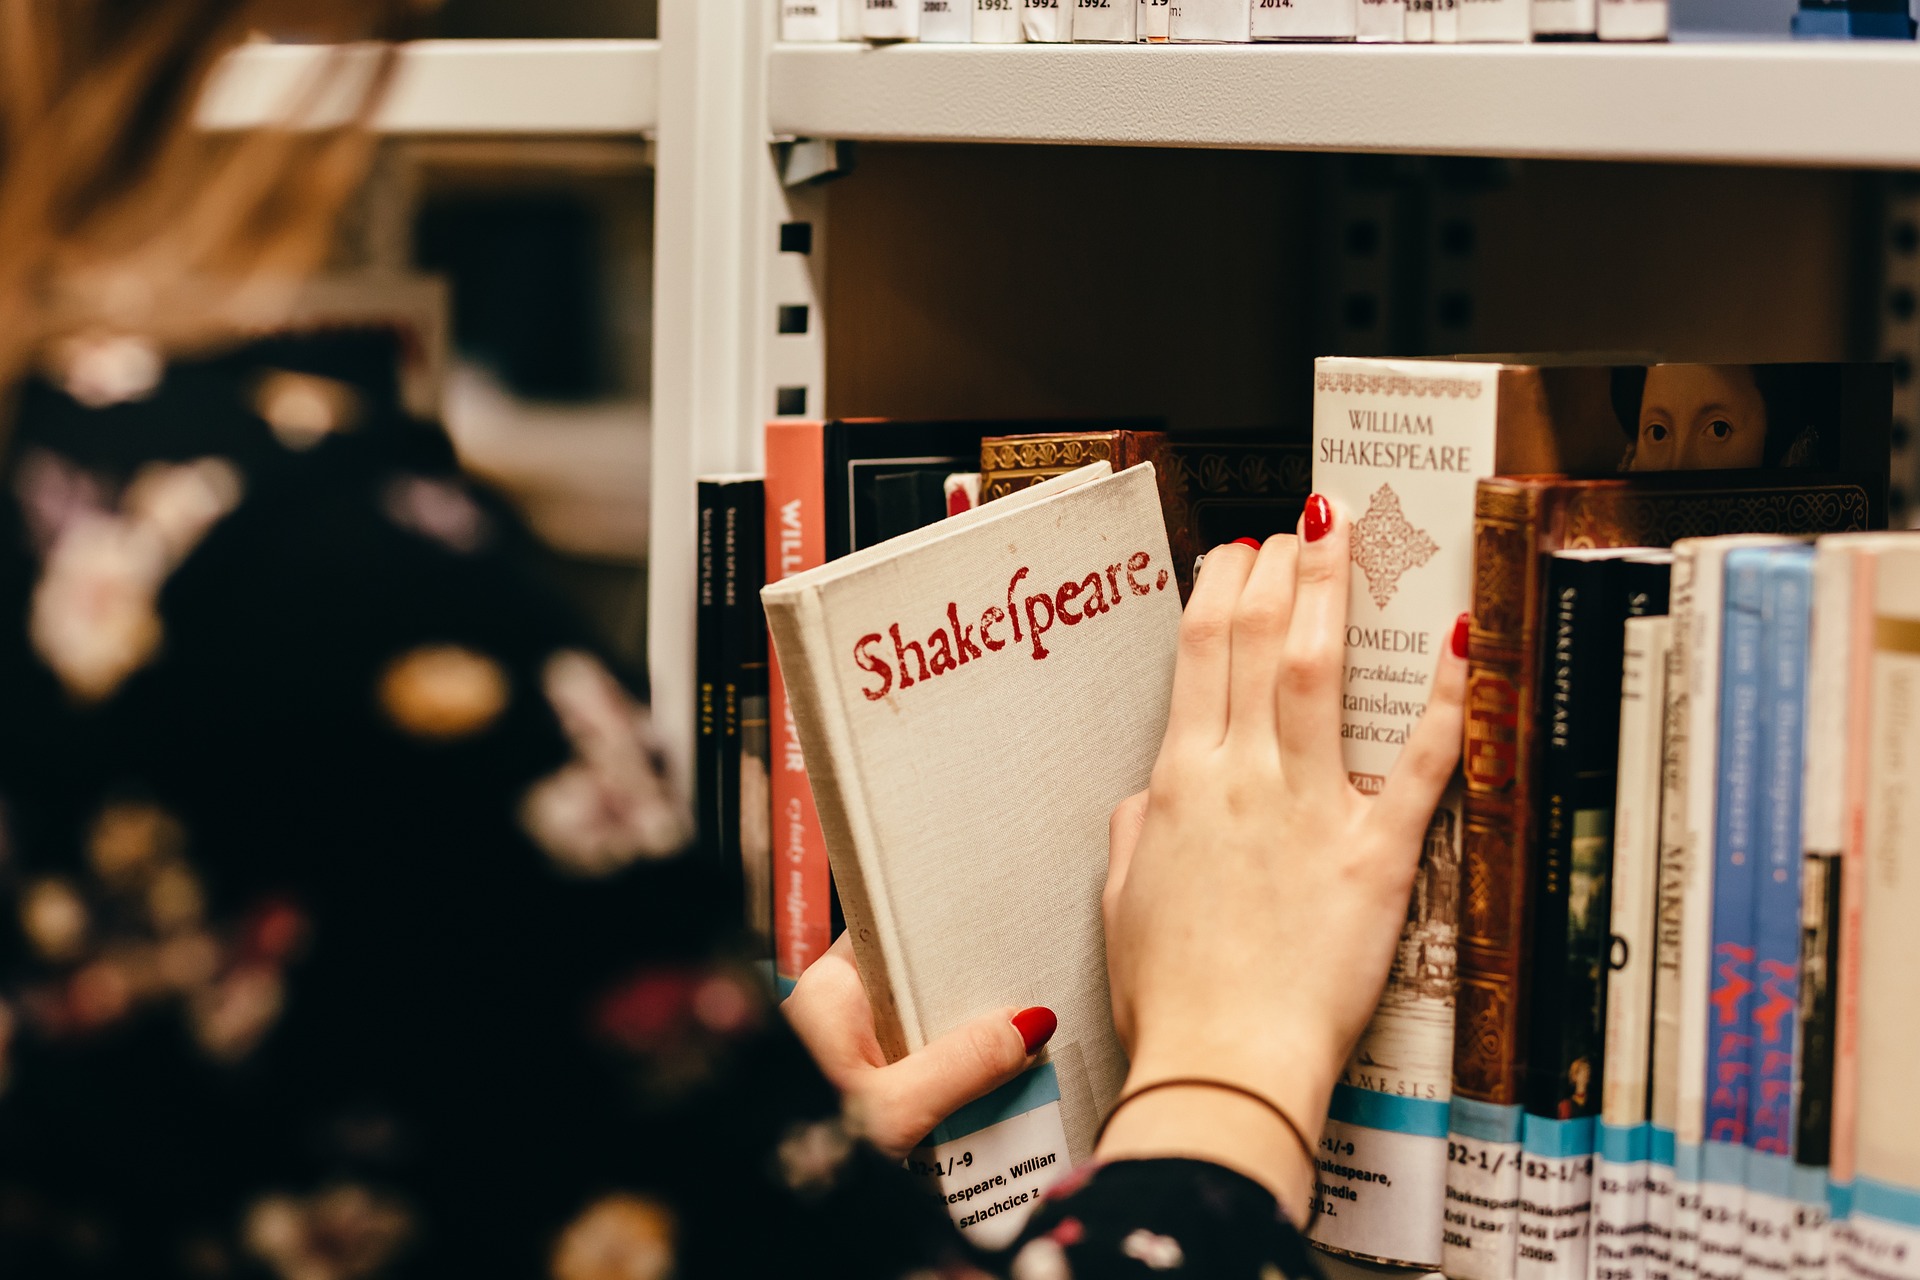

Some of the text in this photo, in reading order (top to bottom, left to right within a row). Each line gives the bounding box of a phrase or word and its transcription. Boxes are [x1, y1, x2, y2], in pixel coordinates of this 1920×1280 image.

[977, 0, 1013, 10] 1992.
[1077, 0, 1111, 8] 1992.
[1348, 409, 1434, 436] WILLIAM
[1319, 437, 1472, 474] SHAKESPEARE
[1344, 625, 1430, 655] OMEDIE
[1552, 587, 1577, 747] SHAKESPEARE
[1342, 692, 1427, 718] tanisława
[1340, 721, 1410, 746] arańcza
[1319, 1138, 1355, 1156] -1/-9
[1314, 1157, 1392, 1188] hakespeare,
[937, 1174, 1007, 1207] kespeare,
[1312, 1181, 1357, 1202] omedie
[959, 1192, 1029, 1229] szlachcice
[1032, 1187, 1041, 1199] z
